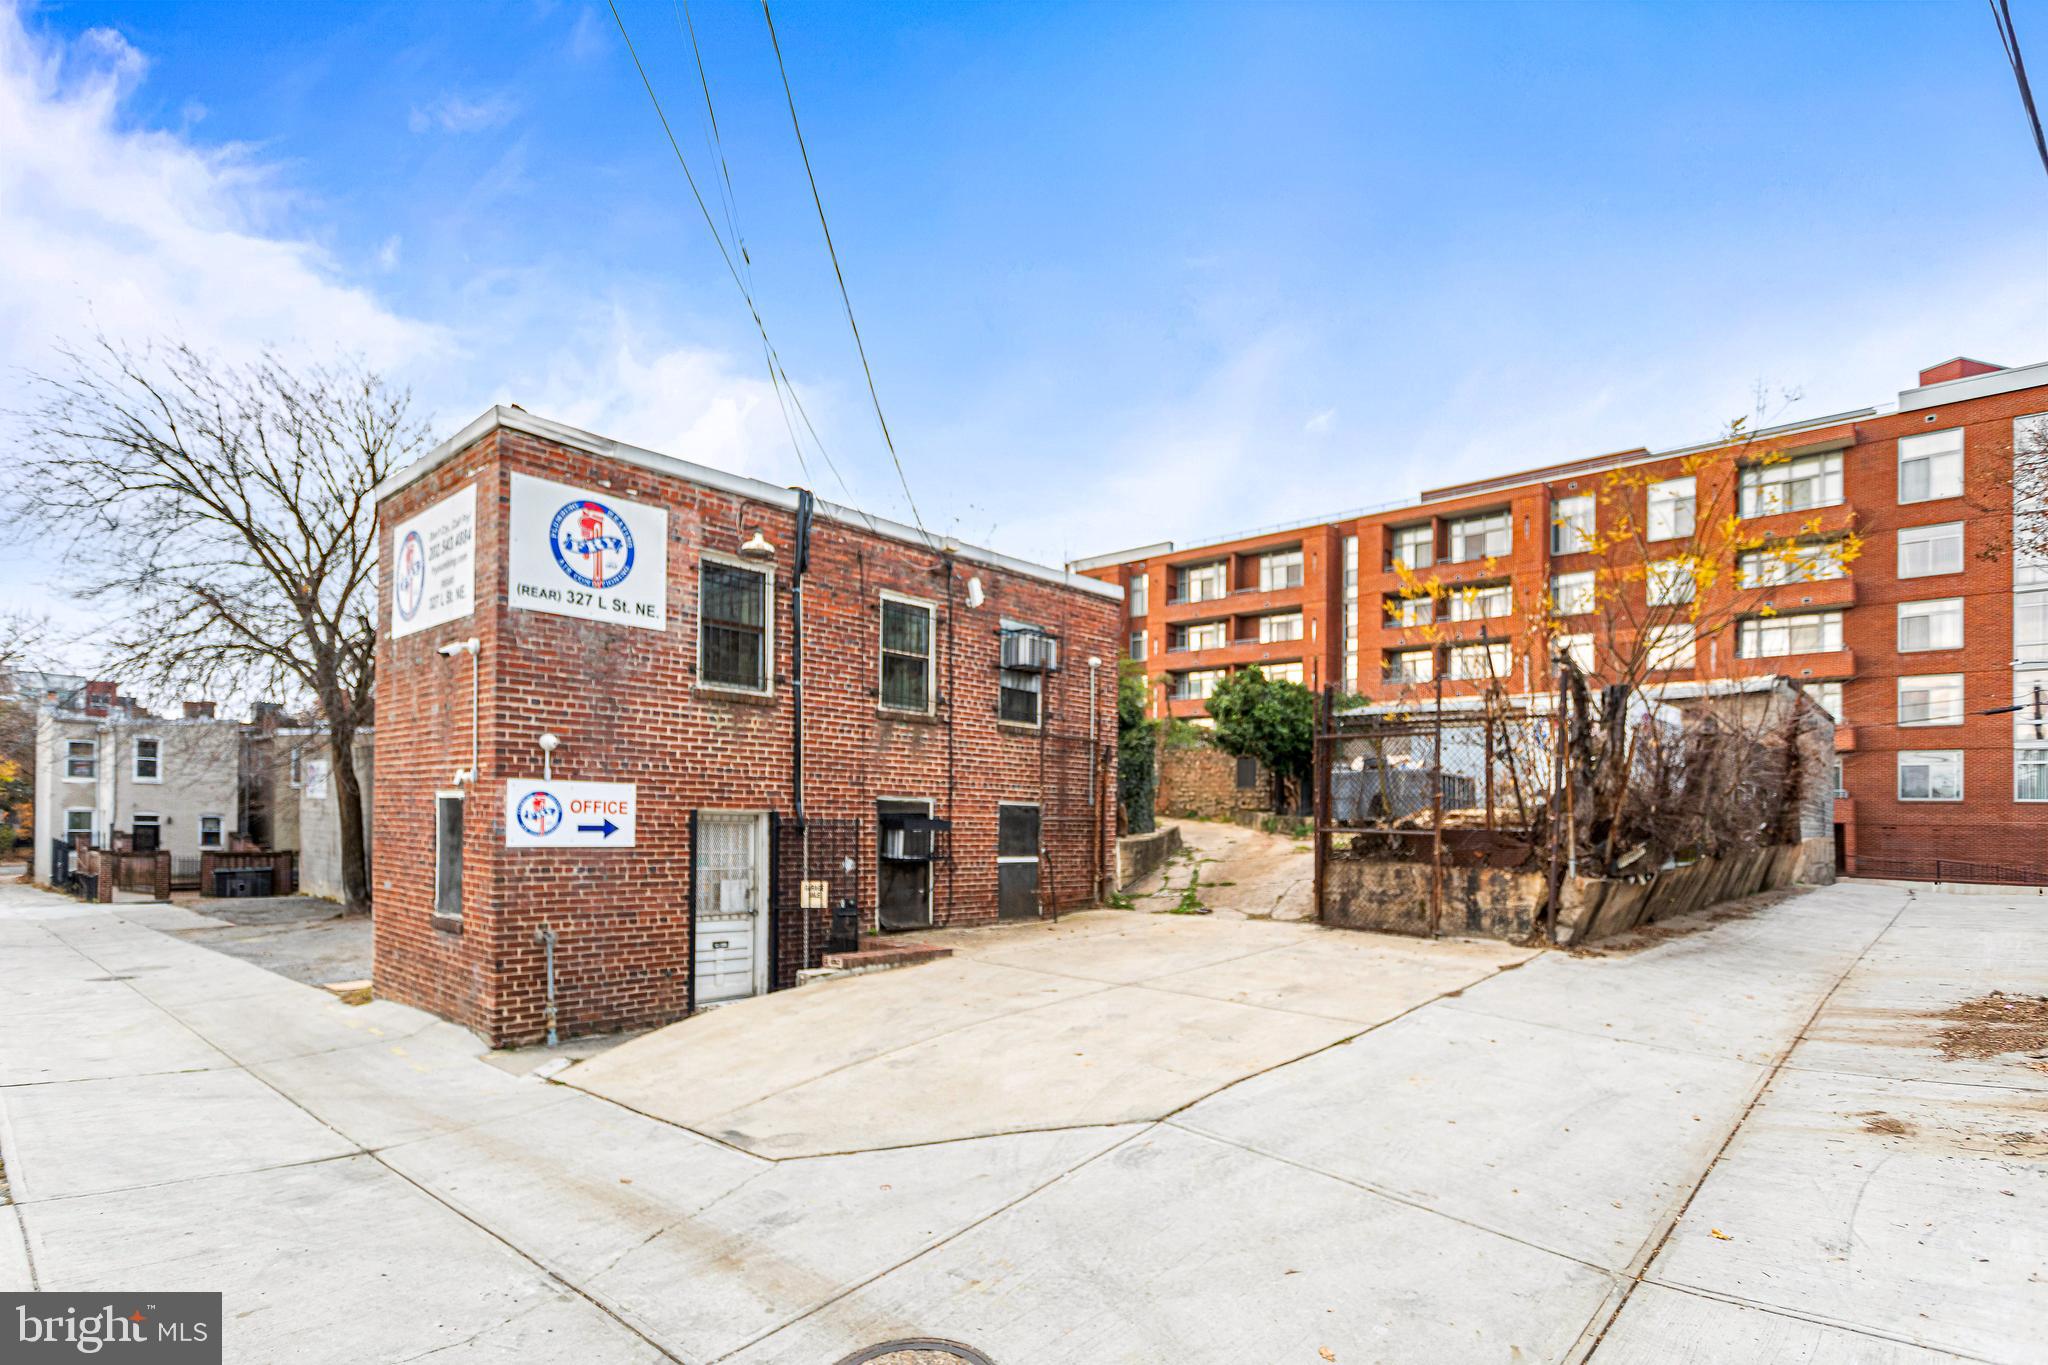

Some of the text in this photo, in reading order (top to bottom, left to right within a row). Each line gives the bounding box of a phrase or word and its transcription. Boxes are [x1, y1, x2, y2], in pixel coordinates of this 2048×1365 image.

[516, 583, 660, 618] (REAR) 327 L St. NE.
[570, 799, 628, 815] OFFICE
